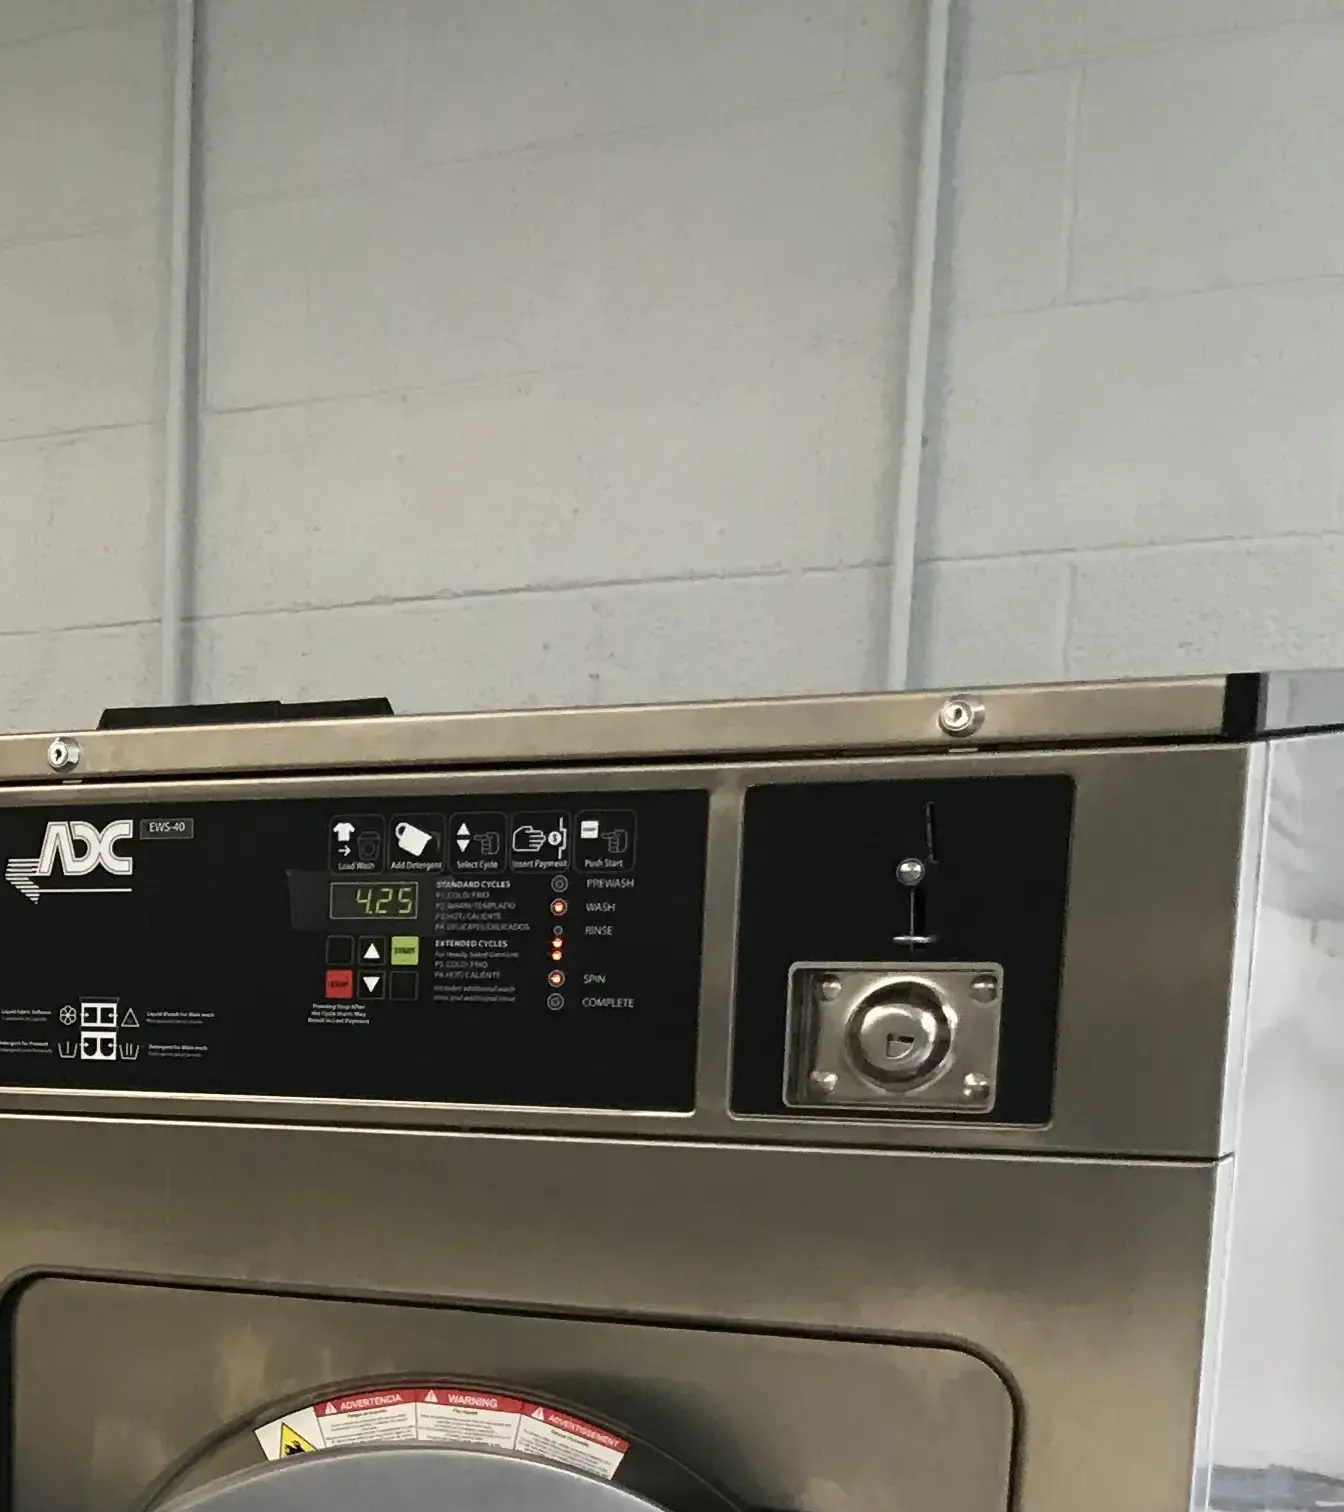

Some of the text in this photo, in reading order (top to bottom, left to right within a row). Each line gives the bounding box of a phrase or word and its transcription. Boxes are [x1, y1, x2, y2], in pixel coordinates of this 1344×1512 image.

[149, 822, 185, 833] EWS-40
[38, 819, 134, 876] ADC
[391, 861, 442, 871] Add Detergent
[457, 860, 498, 870] Select Cycle
[534, 859, 567, 870] Payment
[584, 859, 623, 867] Push Start
[480, 880, 511, 889] CYCLES
[586, 878, 635, 888] PREWASH
[585, 902, 616, 912] WASH
[584, 925, 613, 935] RINSE
[478, 940, 508, 948] CYCLES
[583, 974, 606, 984] SPIN
[581, 997, 634, 1008] COMPLETE
[340, 1393, 404, 1411] ADVERTENCIA
[447, 1393, 498, 1408] WARNING
